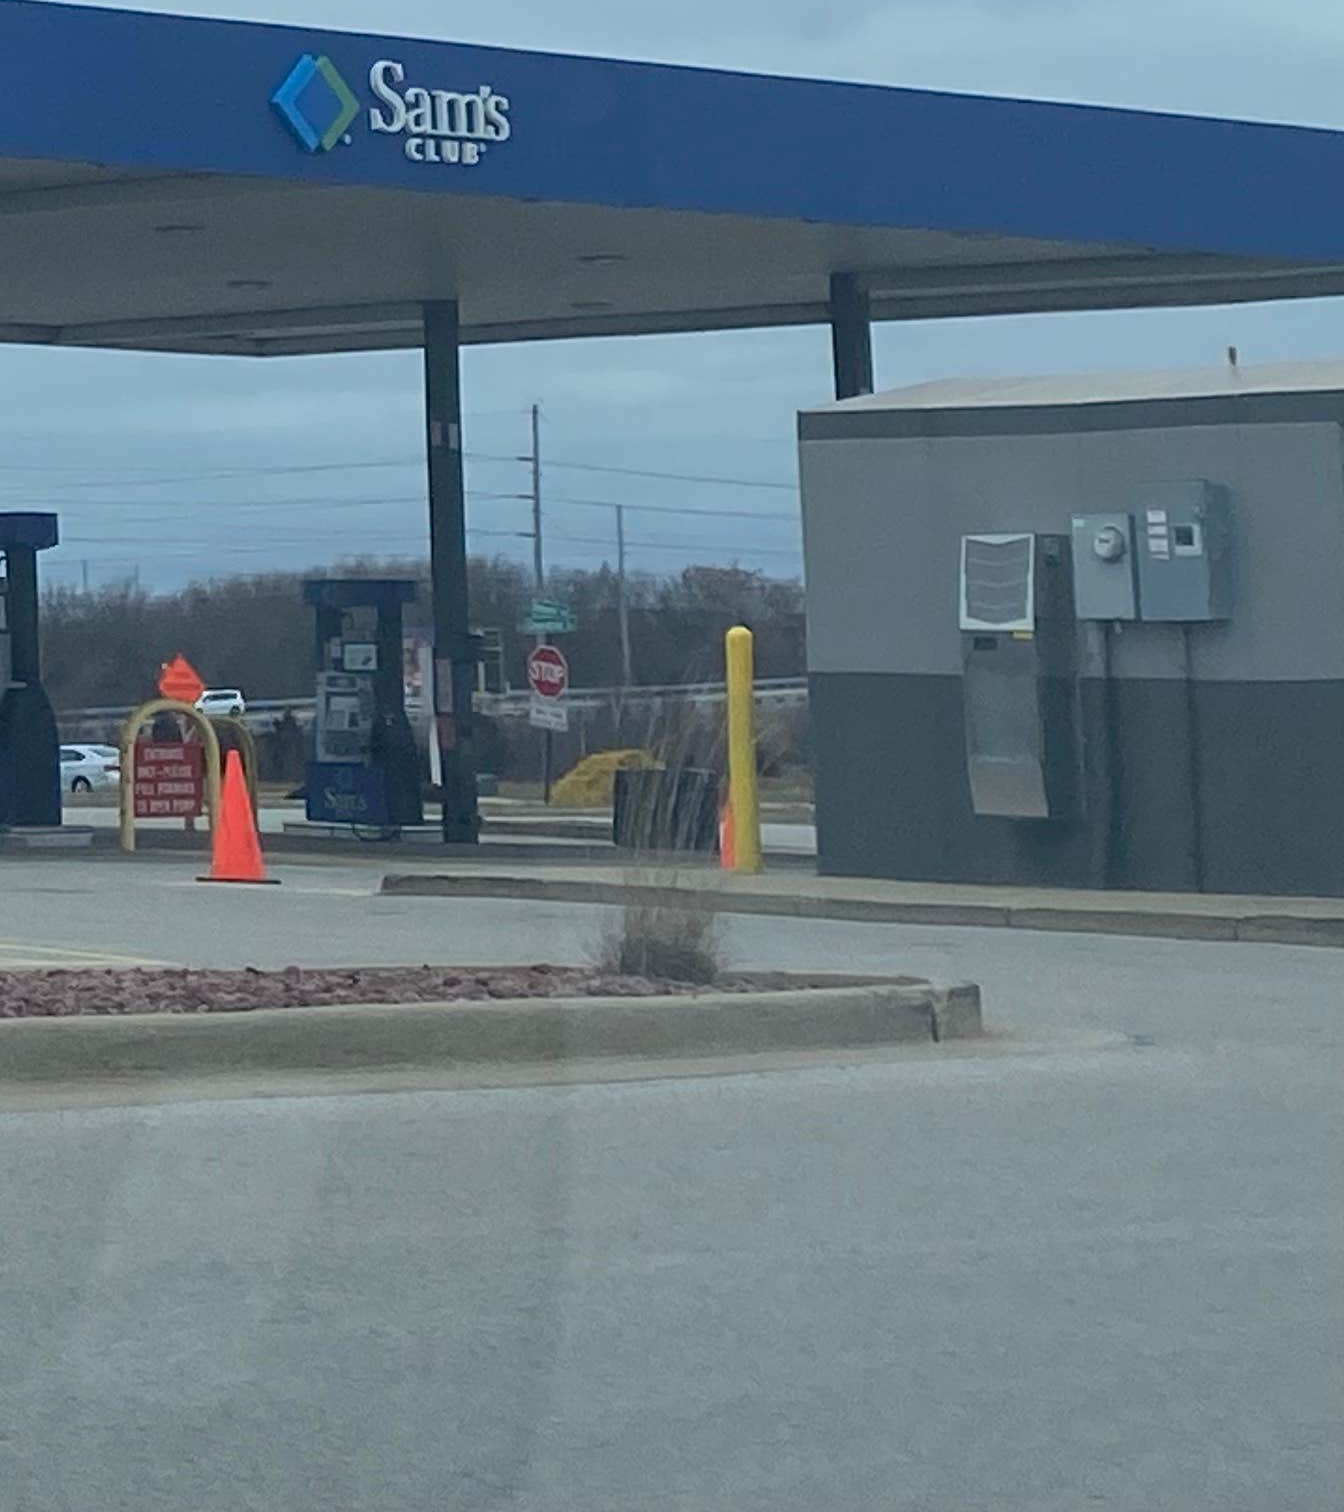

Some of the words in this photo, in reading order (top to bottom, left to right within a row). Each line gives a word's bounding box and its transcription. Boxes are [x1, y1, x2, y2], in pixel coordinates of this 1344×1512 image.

[369, 59, 511, 141] Sam's
[404, 138, 480, 165] CLUB
[528, 660, 565, 685] STOP
